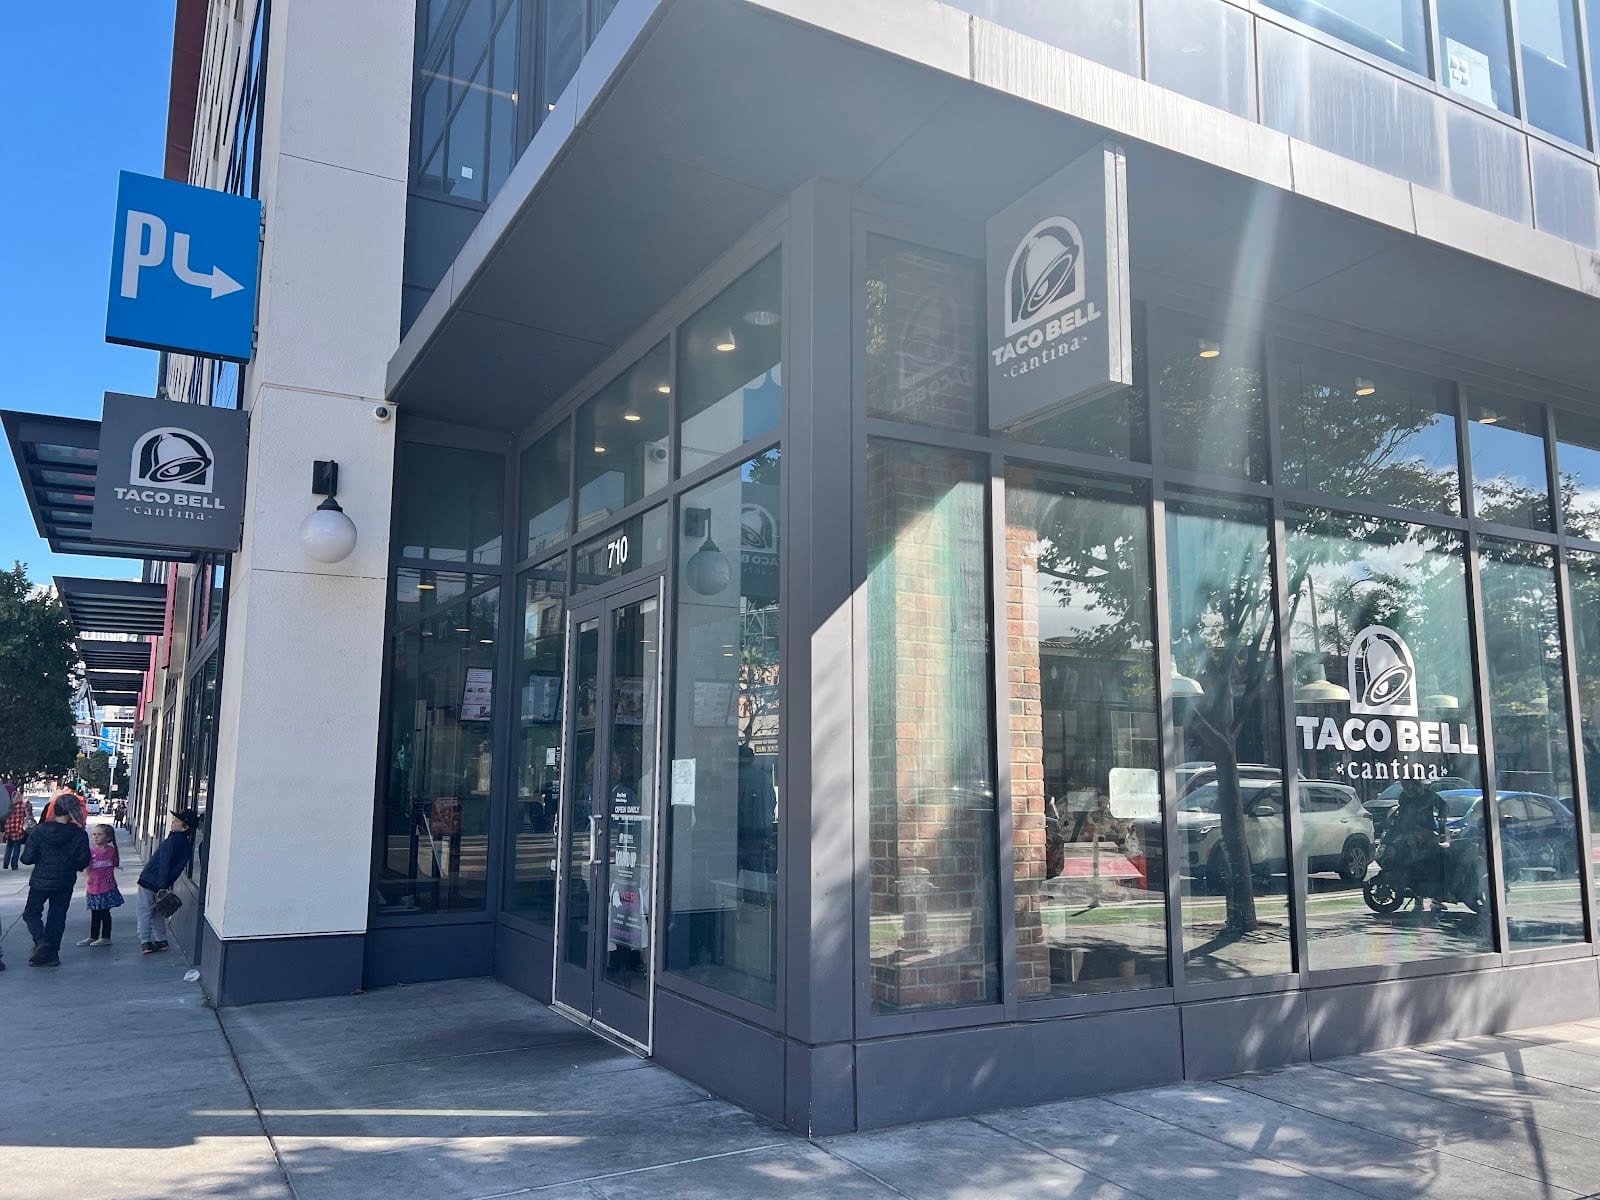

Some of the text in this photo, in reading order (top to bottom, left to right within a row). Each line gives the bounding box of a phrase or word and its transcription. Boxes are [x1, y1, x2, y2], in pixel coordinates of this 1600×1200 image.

[121, 210, 167, 299] P
[992, 302, 1101, 366] TACO BELL
[1010, 337, 1080, 377] cantina
[114, 487, 226, 510] TACO BELL
[133, 505, 205, 520] cantina
[608, 535, 628, 569] 710
[1295, 716, 1479, 755] TACO BELL
[1347, 755, 1438, 780] cantina
[614, 805, 641, 814] OPEN DAILY
